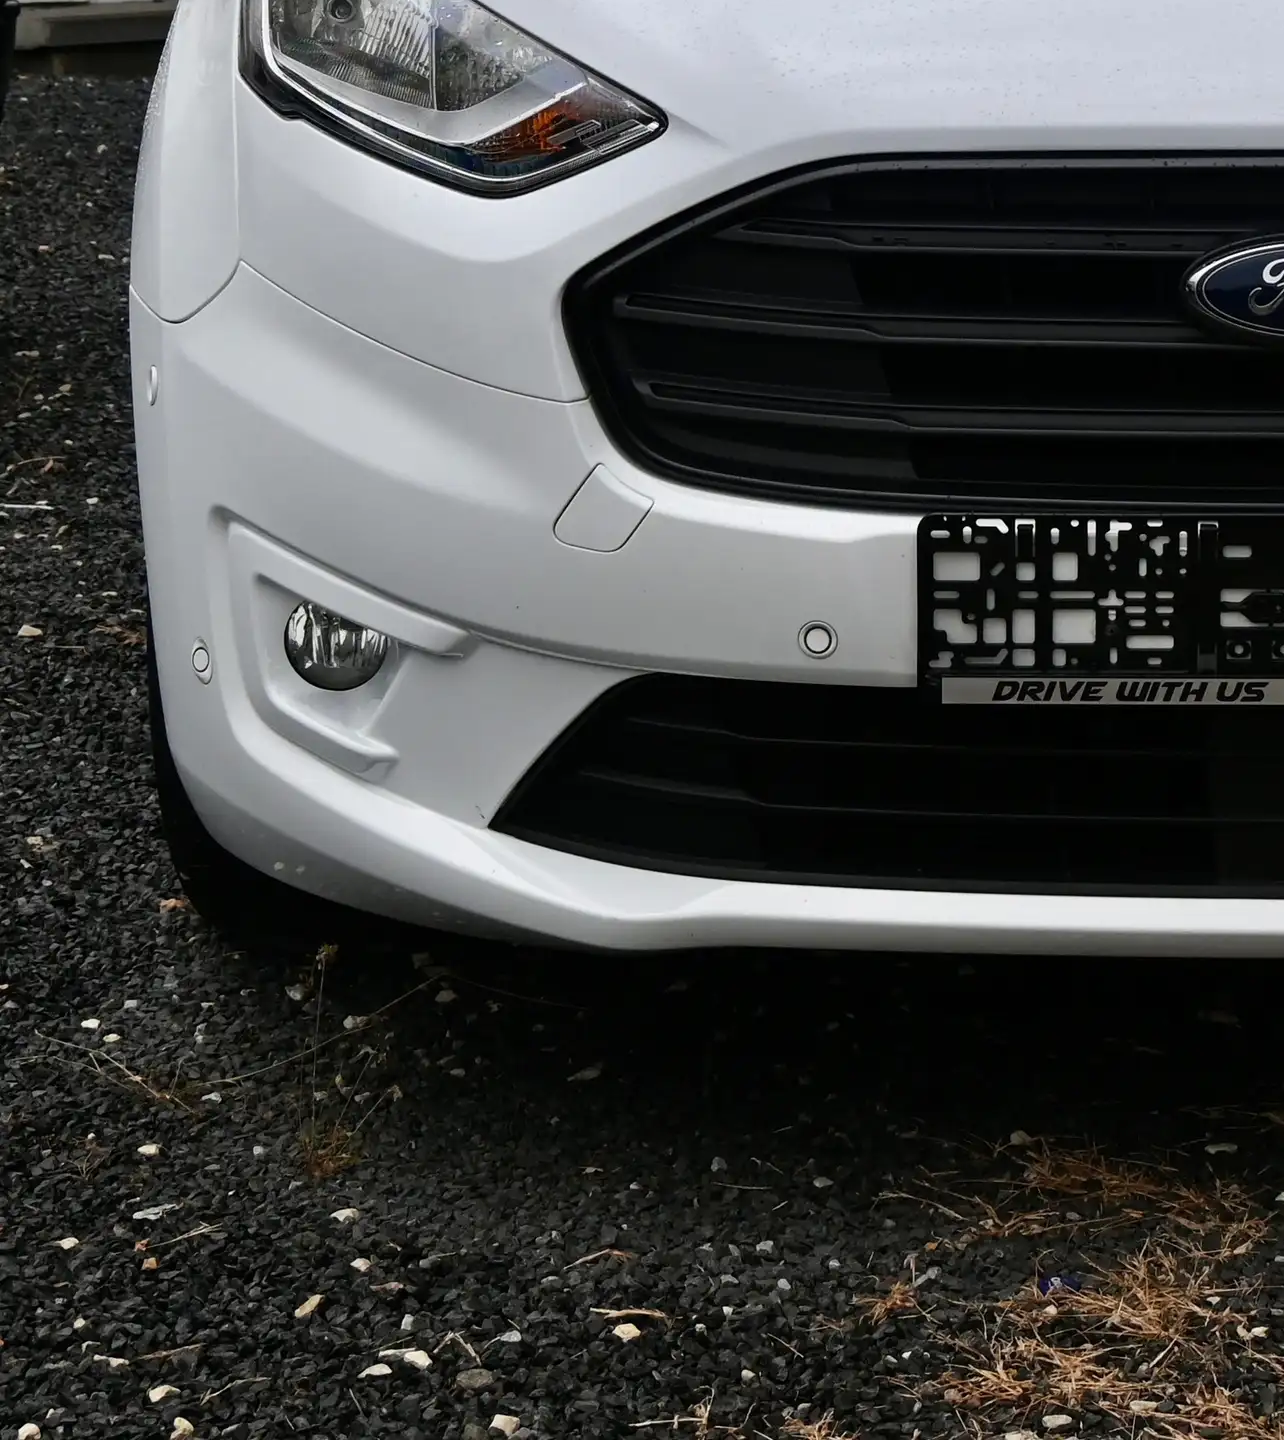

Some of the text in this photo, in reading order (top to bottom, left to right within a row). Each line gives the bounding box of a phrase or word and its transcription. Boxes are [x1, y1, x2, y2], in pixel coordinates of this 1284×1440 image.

[991, 680, 1108, 702] DRIVE
[1115, 680, 1209, 702] WITH
[1215, 681, 1270, 702] US
